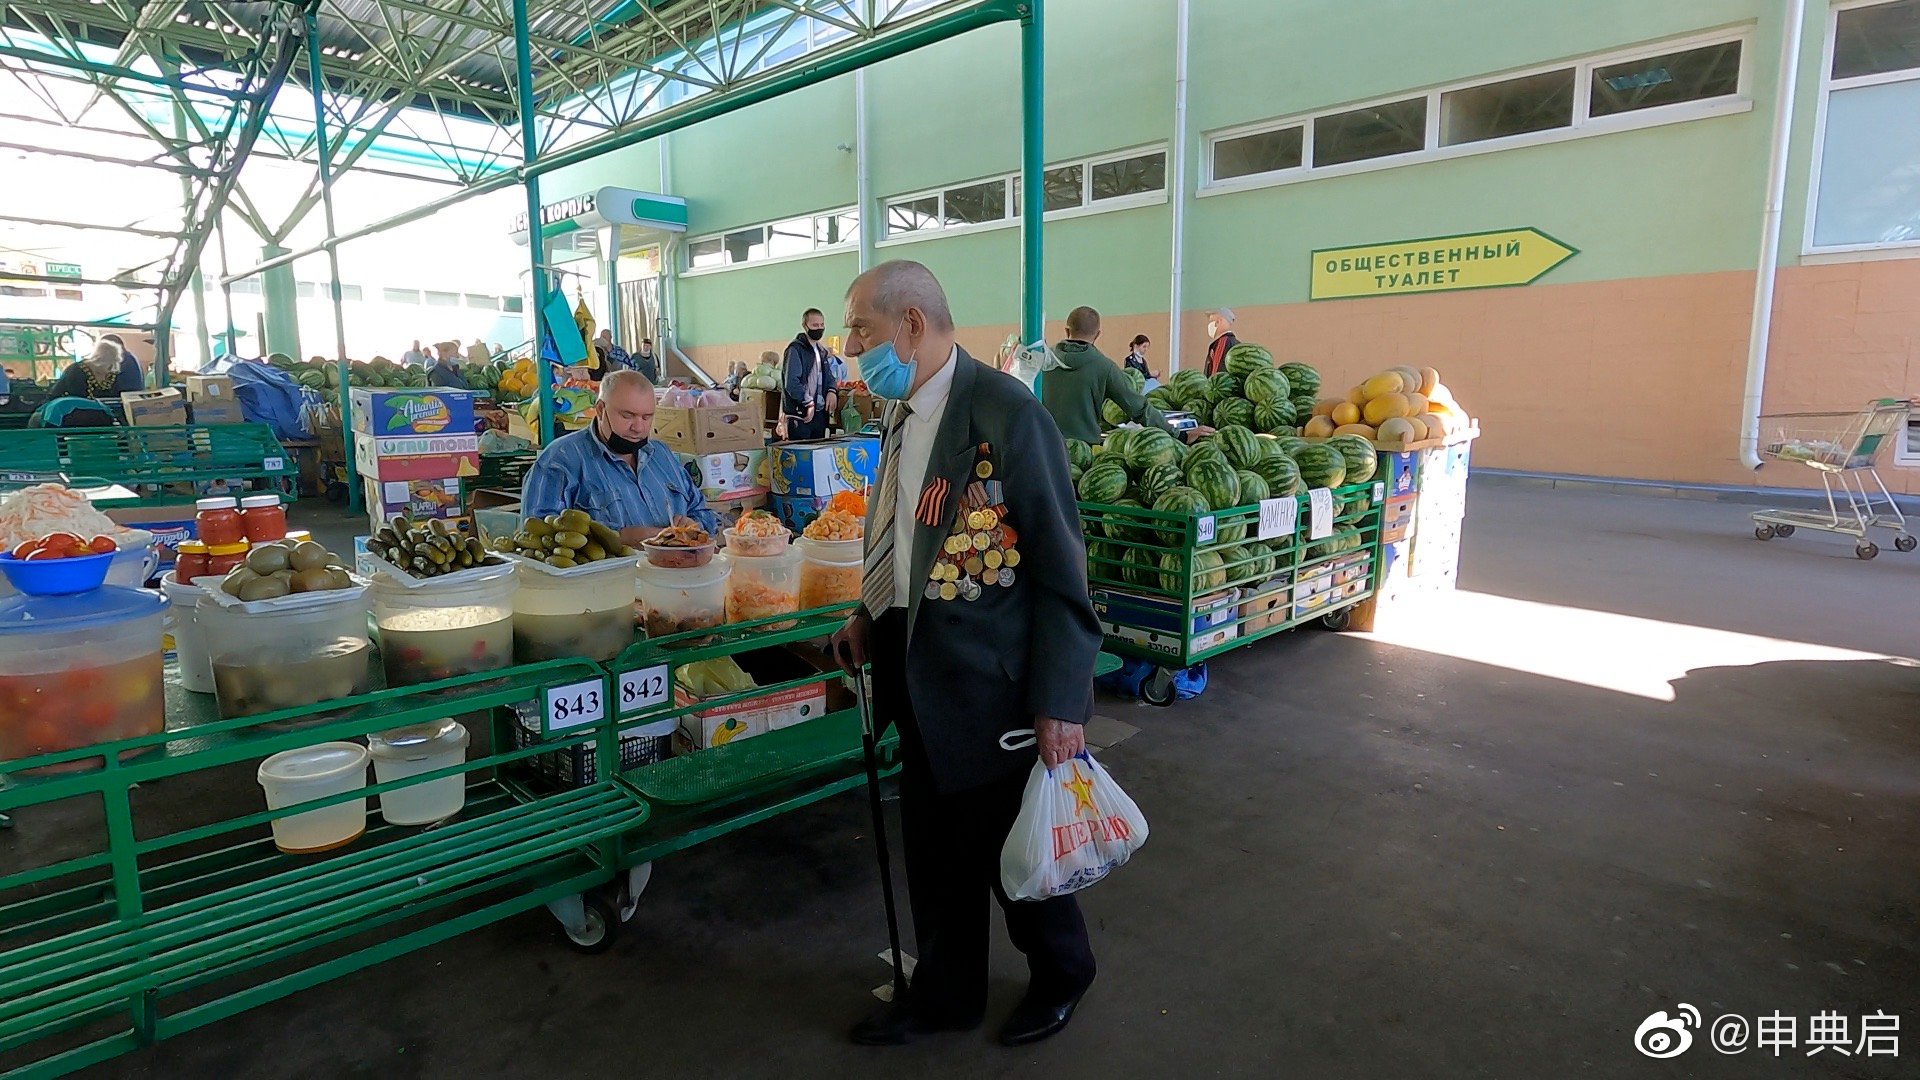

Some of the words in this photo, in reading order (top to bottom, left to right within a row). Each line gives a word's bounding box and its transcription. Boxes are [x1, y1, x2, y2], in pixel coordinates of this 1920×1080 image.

[546, 194, 593, 223] КОРПУС
[1326, 240, 1521, 274] ОБЩЕСТВЕННЫЙ
[1374, 268, 1461, 289] ТУАЛЕТ
[1198, 521, 1213, 538] 840
[622, 674, 665, 703] 842
[554, 690, 600, 721] 843
